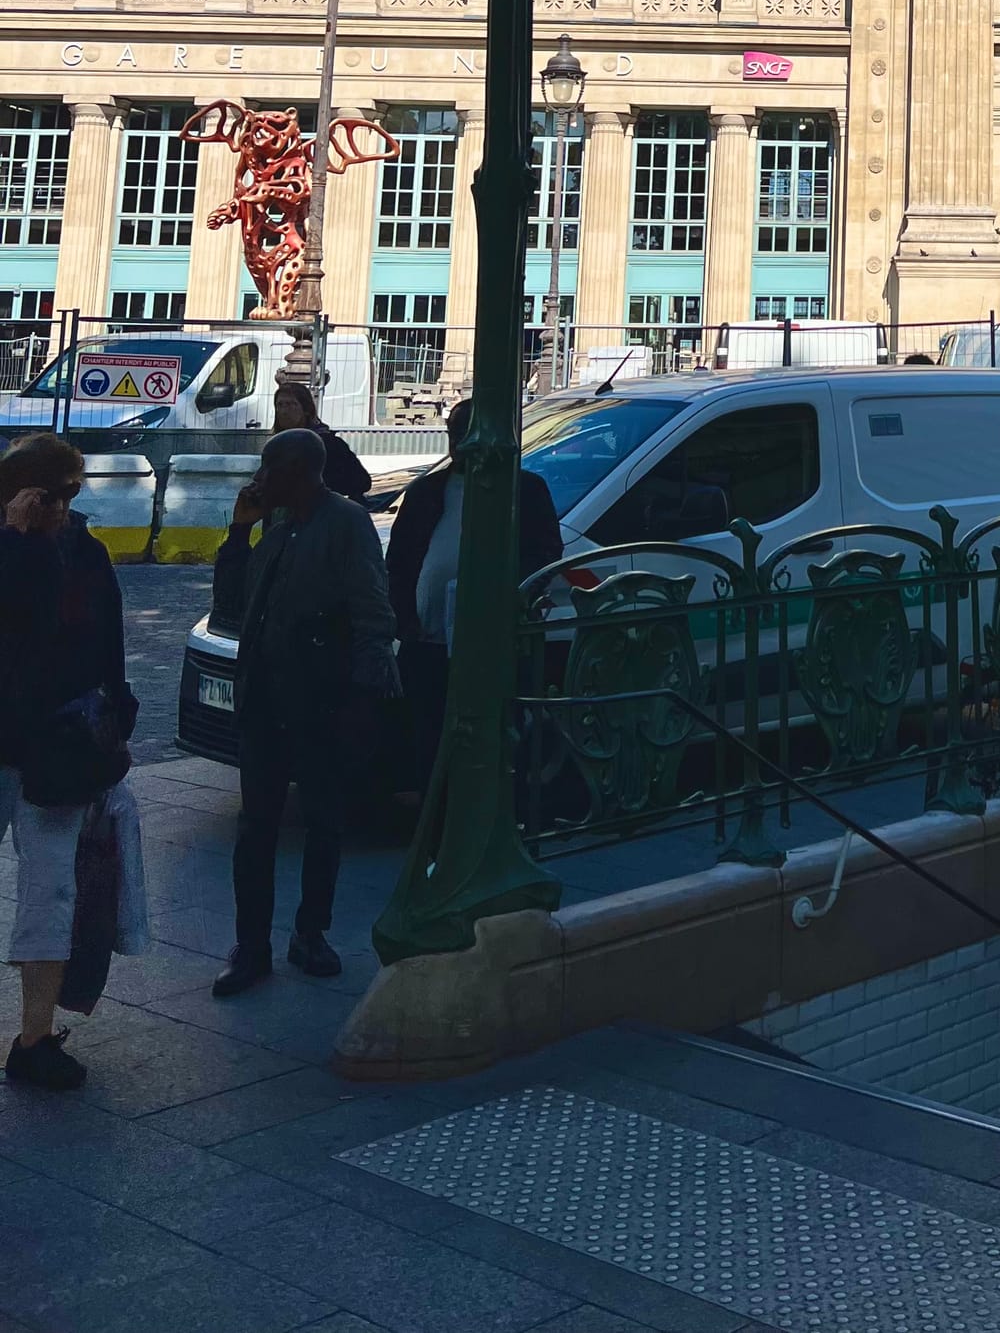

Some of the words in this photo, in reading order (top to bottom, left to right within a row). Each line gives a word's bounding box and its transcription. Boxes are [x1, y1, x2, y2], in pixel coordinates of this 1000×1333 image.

[61, 43, 245, 70] GARE
[314, 47, 389, 72] U
[453, 50, 633, 77] ND
[745, 61, 790, 75] SNCF
